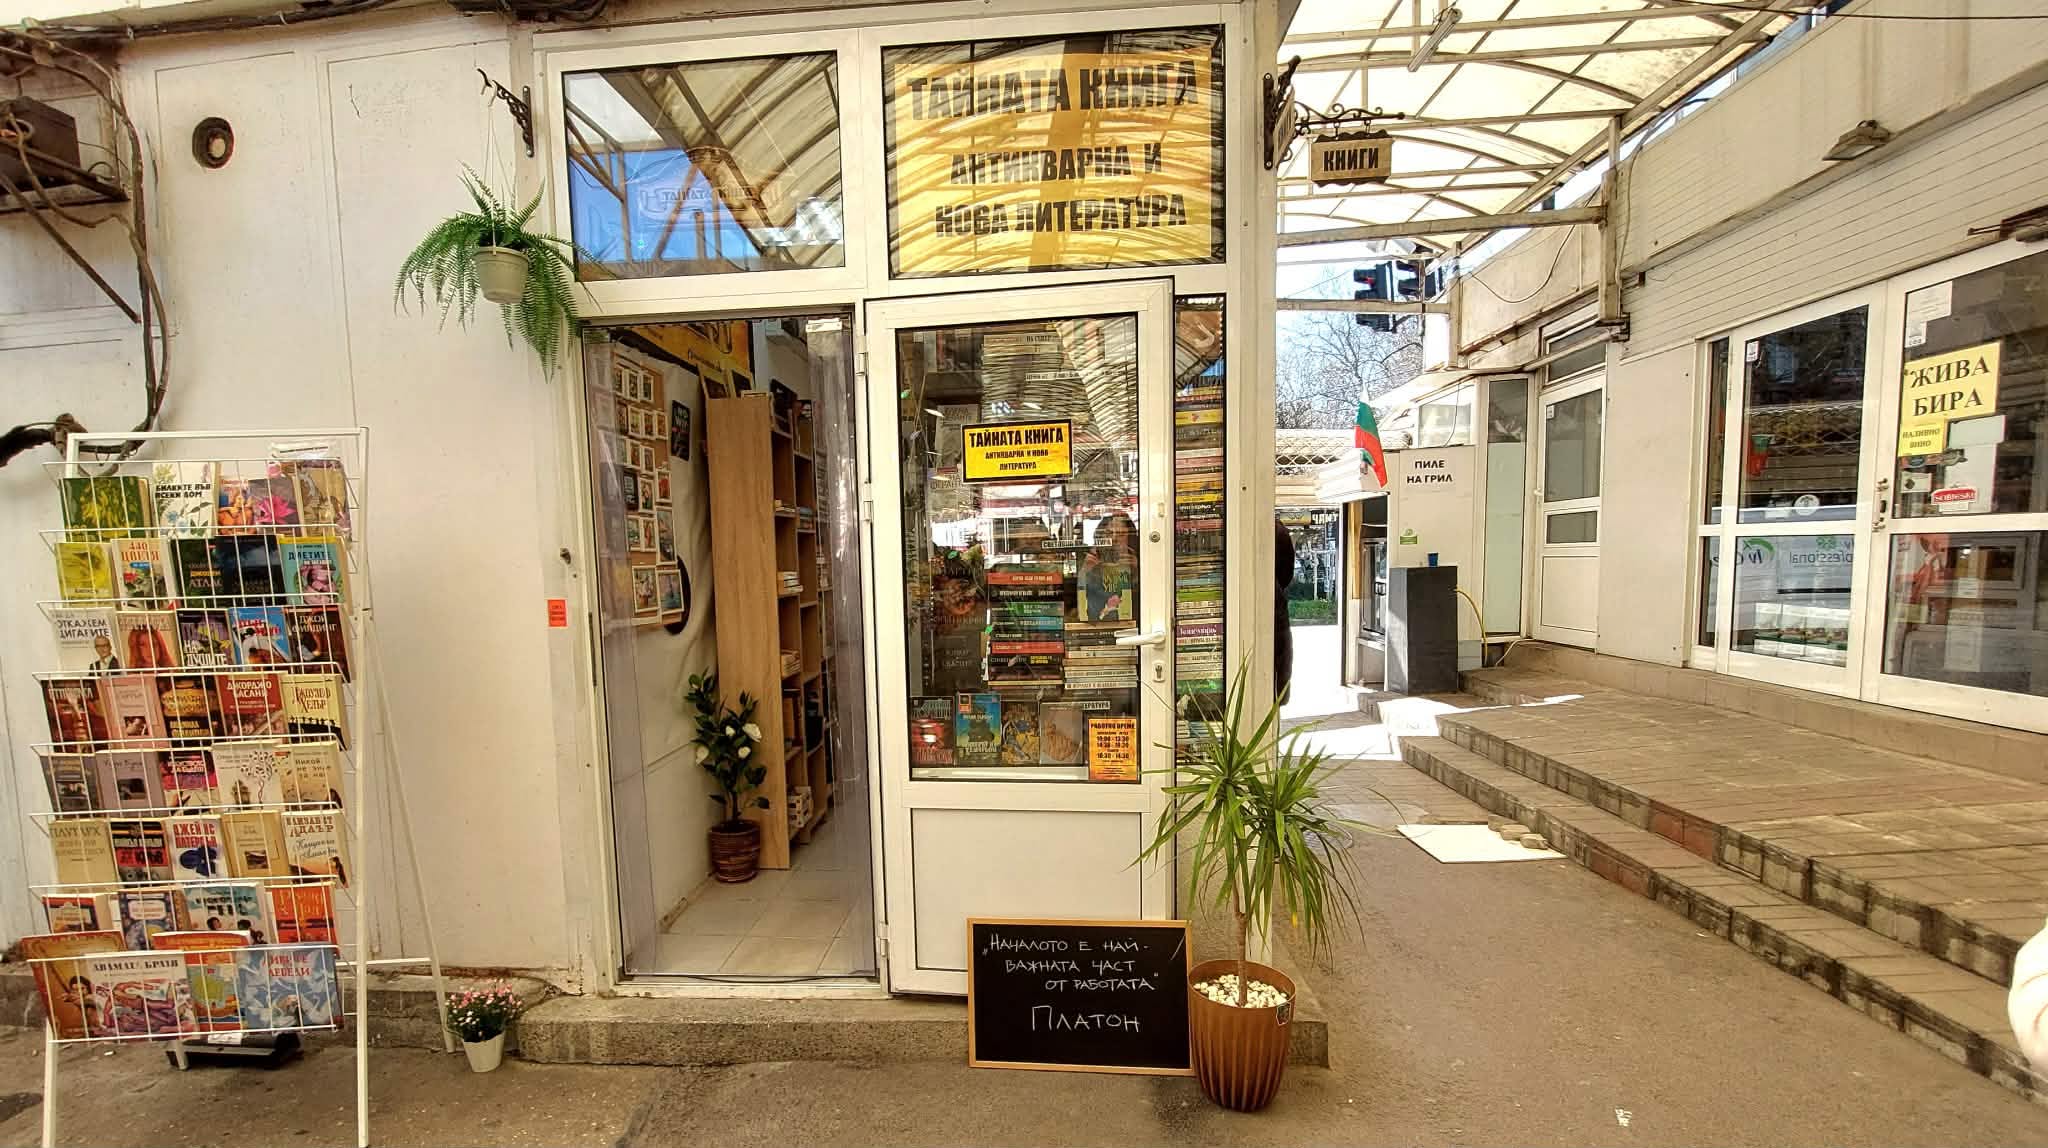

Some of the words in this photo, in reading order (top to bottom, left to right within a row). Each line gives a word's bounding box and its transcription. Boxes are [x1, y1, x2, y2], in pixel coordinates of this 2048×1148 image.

[907, 68, 1071, 121] ТАЙНАТА
[1079, 60, 1199, 111] КНИГА
[951, 145, 1132, 185] АНТИКВАРНА
[1143, 142, 1162, 174] И
[1323, 147, 1379, 172] КНИГИ
[935, 203, 1010, 238] НОВА
[1014, 194, 1187, 233] ЛИТЕРАТУРА
[1909, 356, 1991, 390] ЖИВА
[1913, 388, 1984, 418] БИРА
[969, 429, 1022, 448] ТАЙНАТА
[1025, 427, 1064, 445] КНИГА
[985, 450, 1025, 459] АНТИКВАРНА
[1000, 462, 1037, 471] ЛИТЕРАТУРА
[1415, 460, 1445, 469] ПИЛЕ
[1407, 475, 1422, 484] НА
[1425, 474, 1453, 483] ГРИЛ
[236, 689, 268, 697] АСАНИ
[1079, 941, 1092, 951] Е
[1005, 960, 1080, 974] ВАЖНАТА
[1092, 960, 1136, 976] ЧАСТ
[1045, 979, 1069, 992] ОТ
[1032, 1005, 1140, 1033] ПЛАТОН
